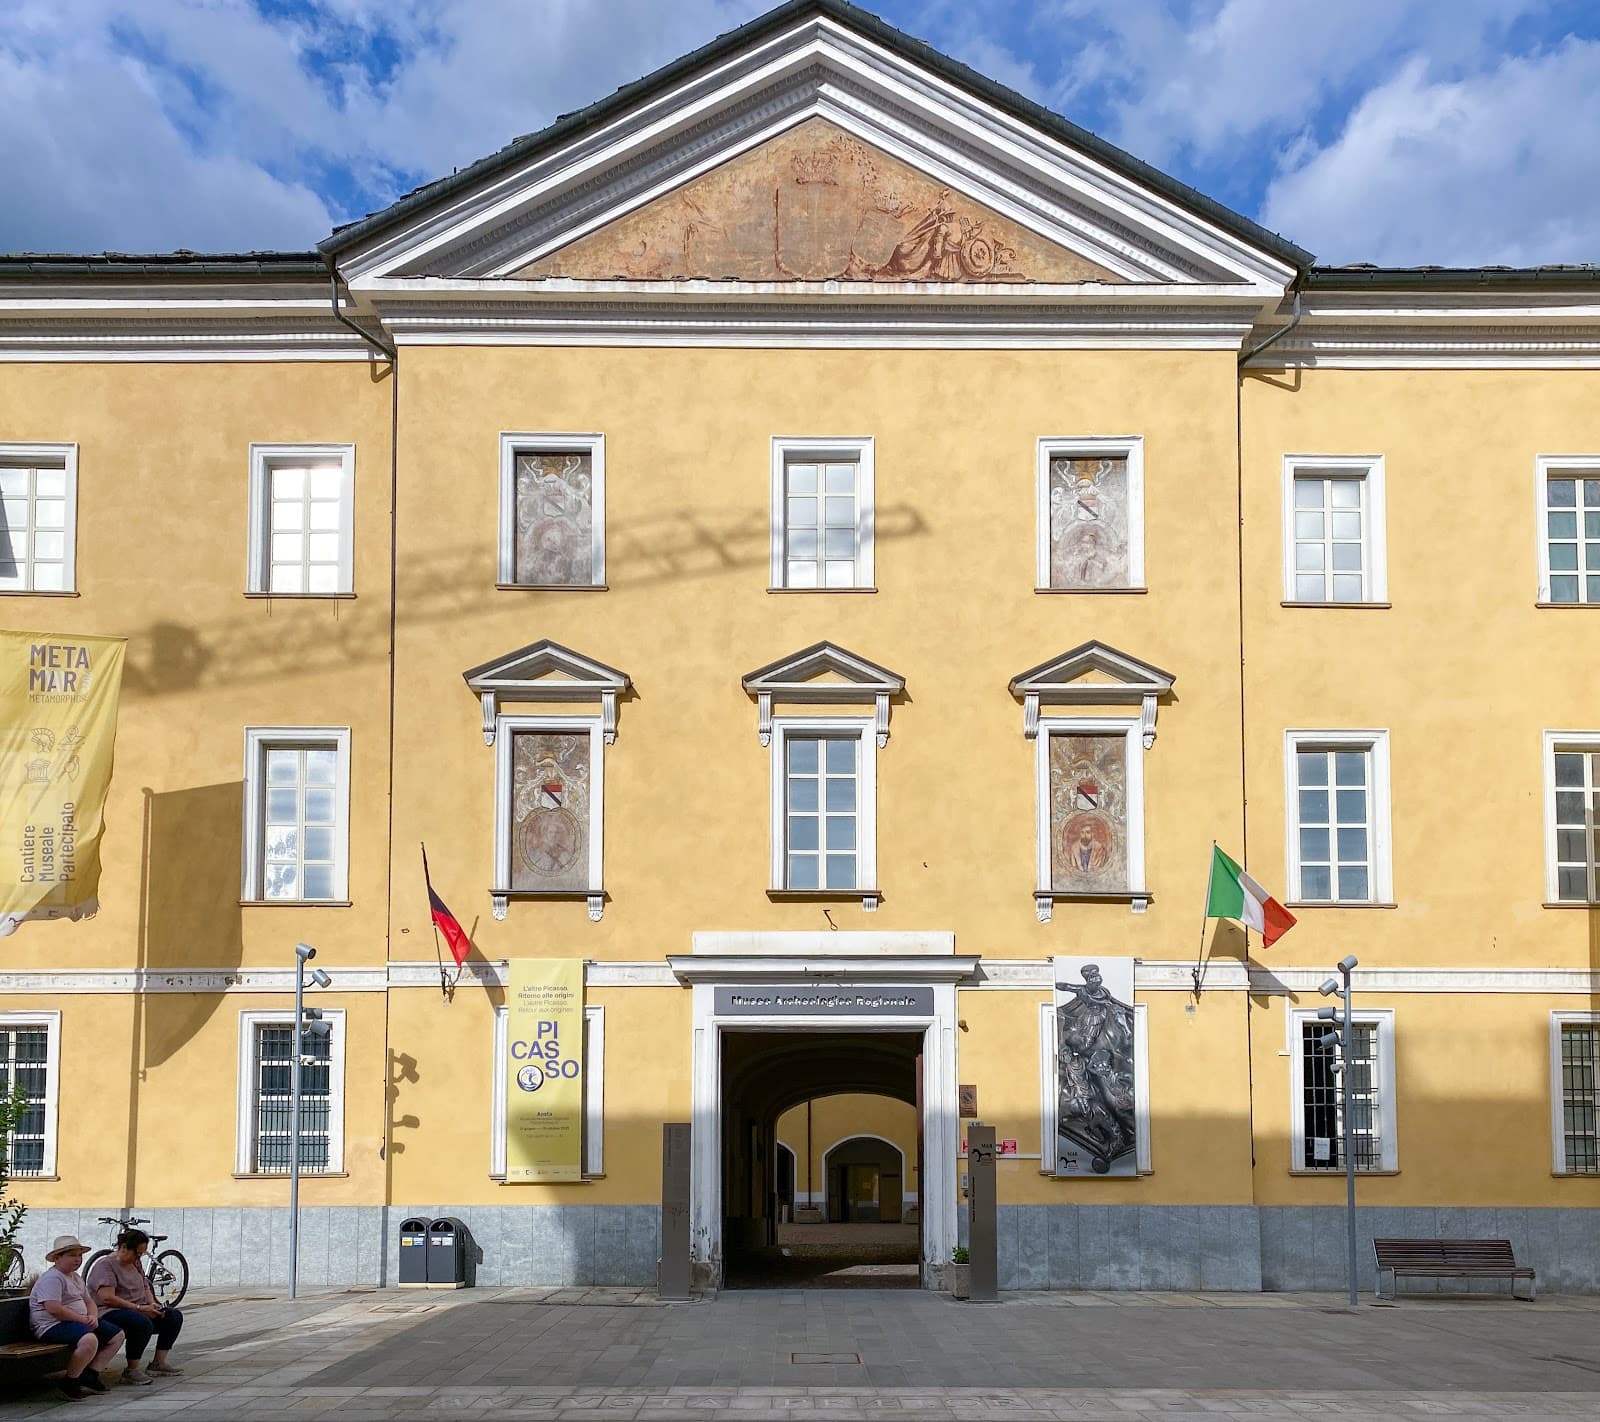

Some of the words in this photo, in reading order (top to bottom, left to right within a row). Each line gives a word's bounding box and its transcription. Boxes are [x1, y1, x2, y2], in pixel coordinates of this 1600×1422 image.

[30, 644, 90, 669] META
[58, 802, 78, 882] Partecipato
[20, 825, 36, 882] Cantiere
[39, 826, 55, 882] Museale
[731, 995, 772, 1006] Museo
[774, 995, 853, 1008] Archeologico
[856, 996, 917, 1008] Regionale
[537, 1021, 558, 1039] PI
[511, 1041, 560, 1060] CAS
[545, 1060, 579, 1079] SO
